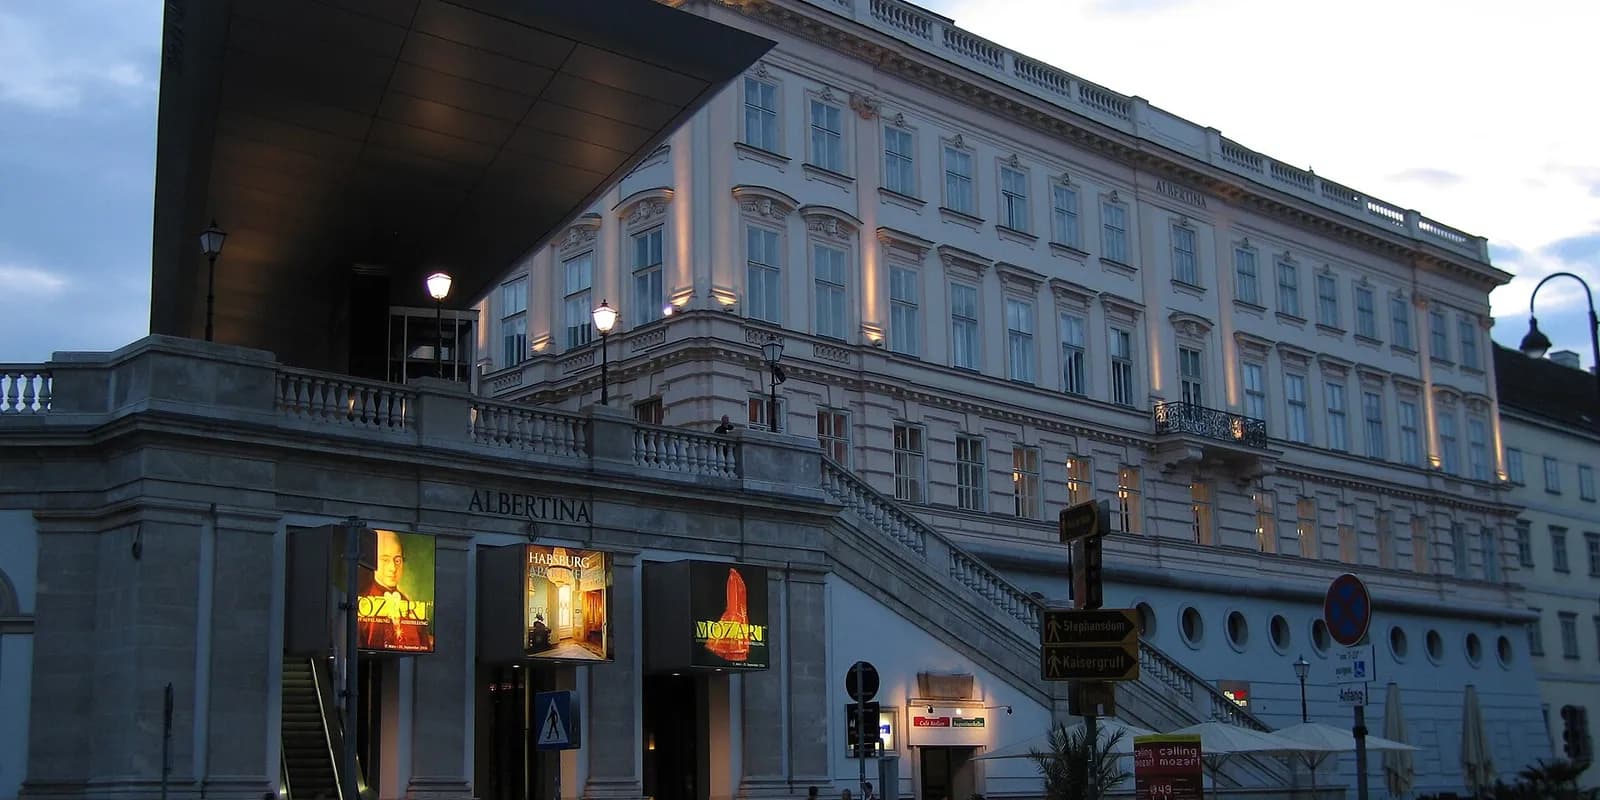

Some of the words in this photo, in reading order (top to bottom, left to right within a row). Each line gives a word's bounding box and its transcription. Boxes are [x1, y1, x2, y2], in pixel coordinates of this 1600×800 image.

[468, 488, 592, 524] ALBERTINA
[529, 552, 590, 568] HABSBURG
[696, 621, 768, 642] MOZART
[1063, 620, 1125, 633] Stephansdom
[1063, 655, 1125, 672] Kaisergruft
[1159, 746, 1197, 758] calling
[1159, 757, 1201, 768] mozart
